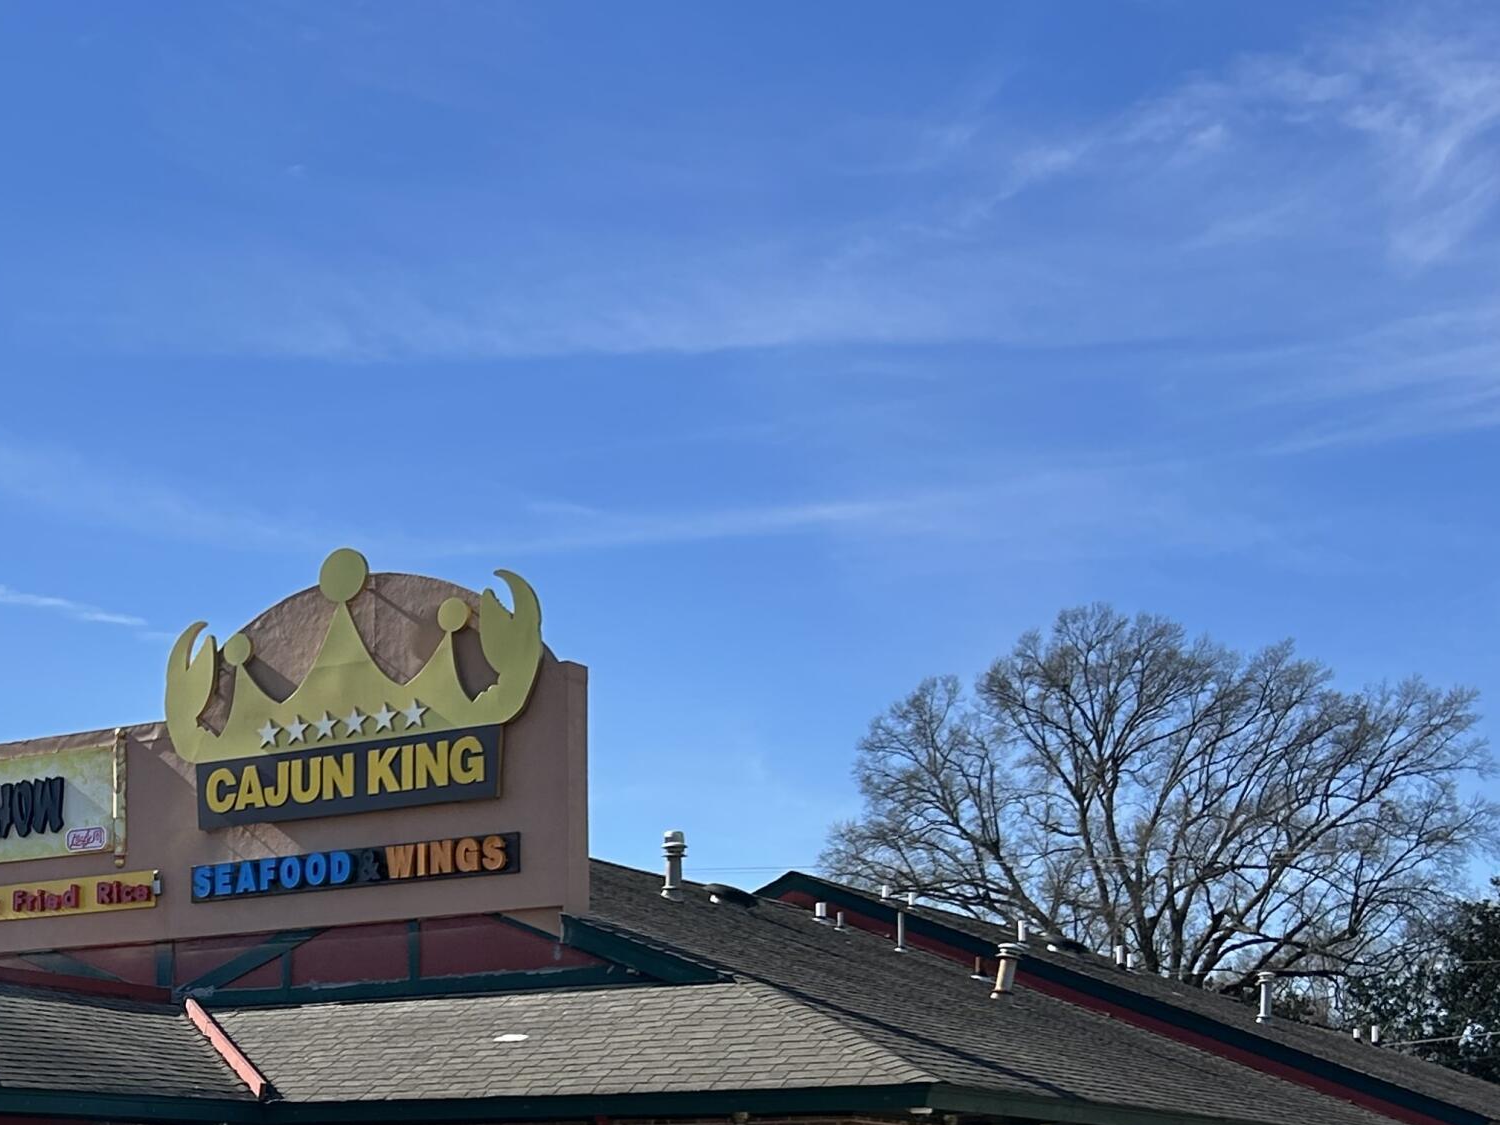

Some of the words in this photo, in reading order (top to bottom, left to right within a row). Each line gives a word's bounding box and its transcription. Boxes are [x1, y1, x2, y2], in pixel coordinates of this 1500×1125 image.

[205, 751, 355, 815] CAJUN
[366, 735, 486, 795] KING
[11, 884, 81, 913] Fried
[96, 880, 152, 905] Rice
[192, 850, 352, 899] SEAFOOD
[357, 850, 380, 881] &
[385, 834, 510, 881] WINGS
